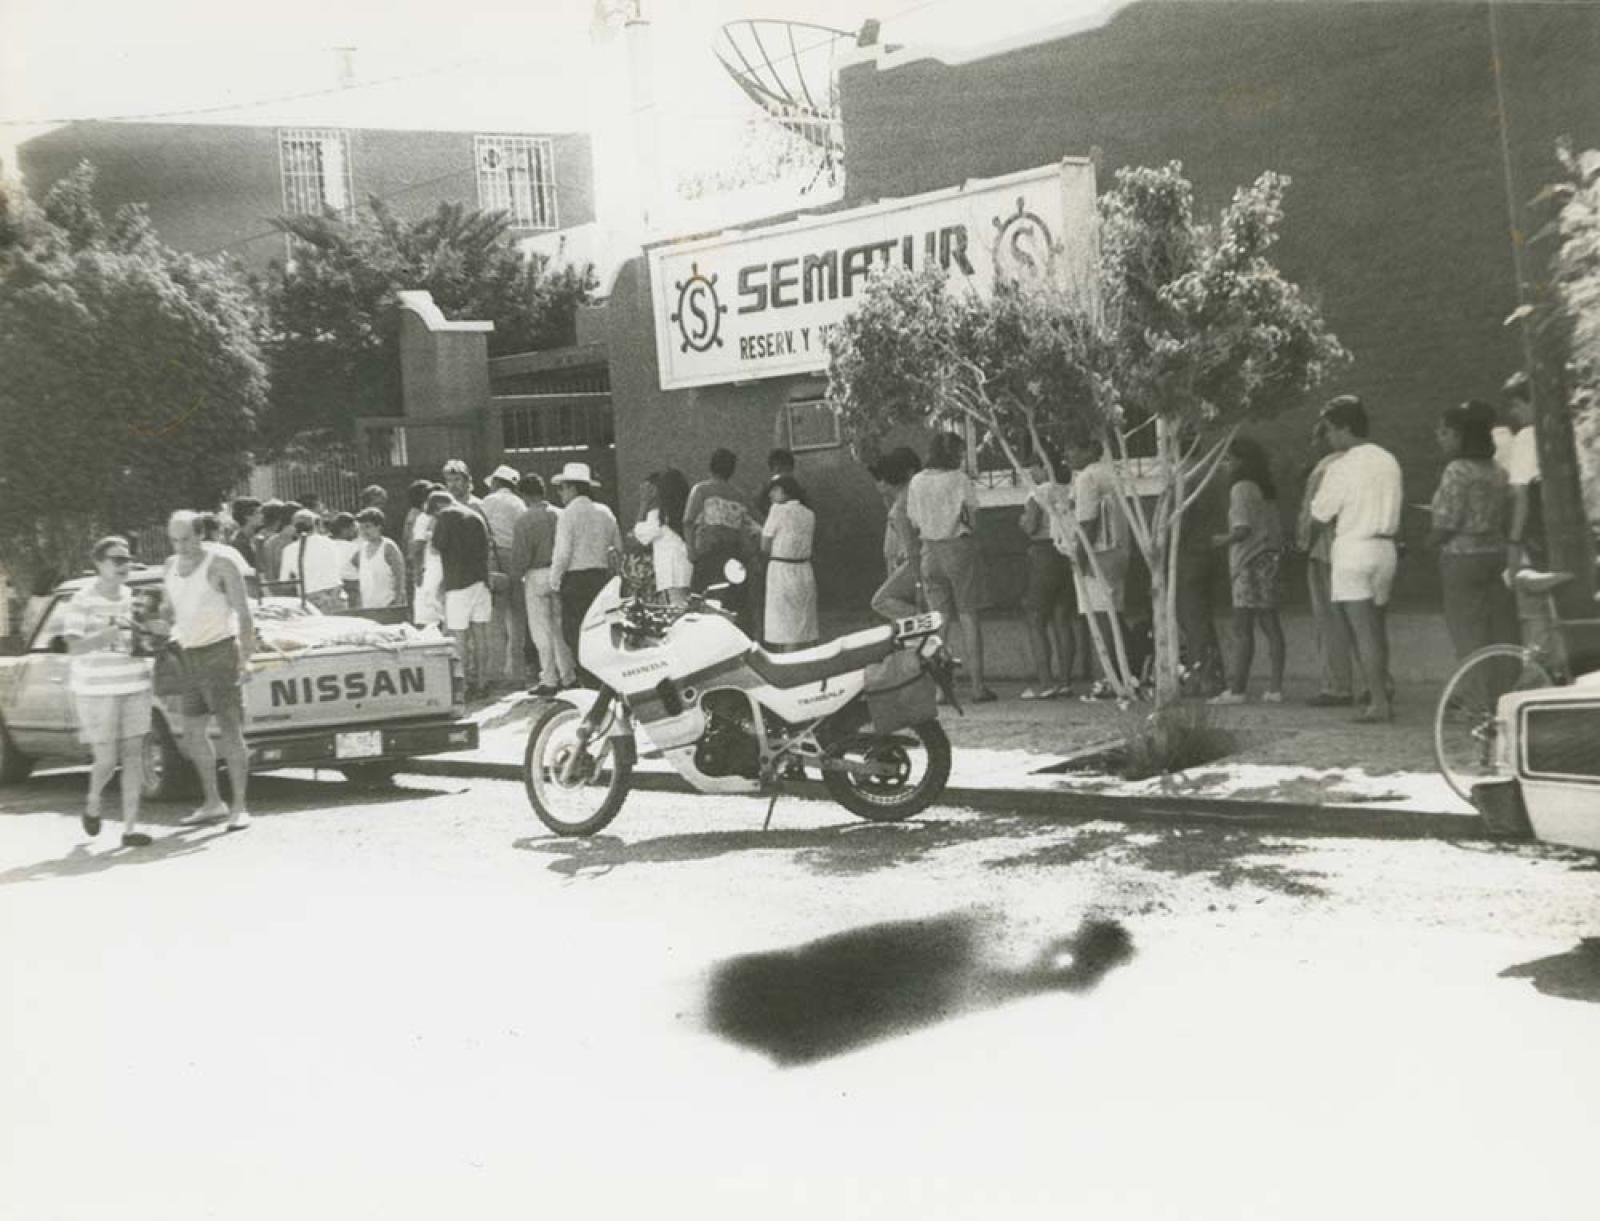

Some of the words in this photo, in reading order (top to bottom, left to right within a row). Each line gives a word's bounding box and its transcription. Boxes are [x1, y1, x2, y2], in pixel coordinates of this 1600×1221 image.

[740, 329, 797, 361] RESERV.
[800, 327, 809, 352] Y
[621, 660, 669, 678] HONDA
[270, 666, 426, 707] NISSAN
